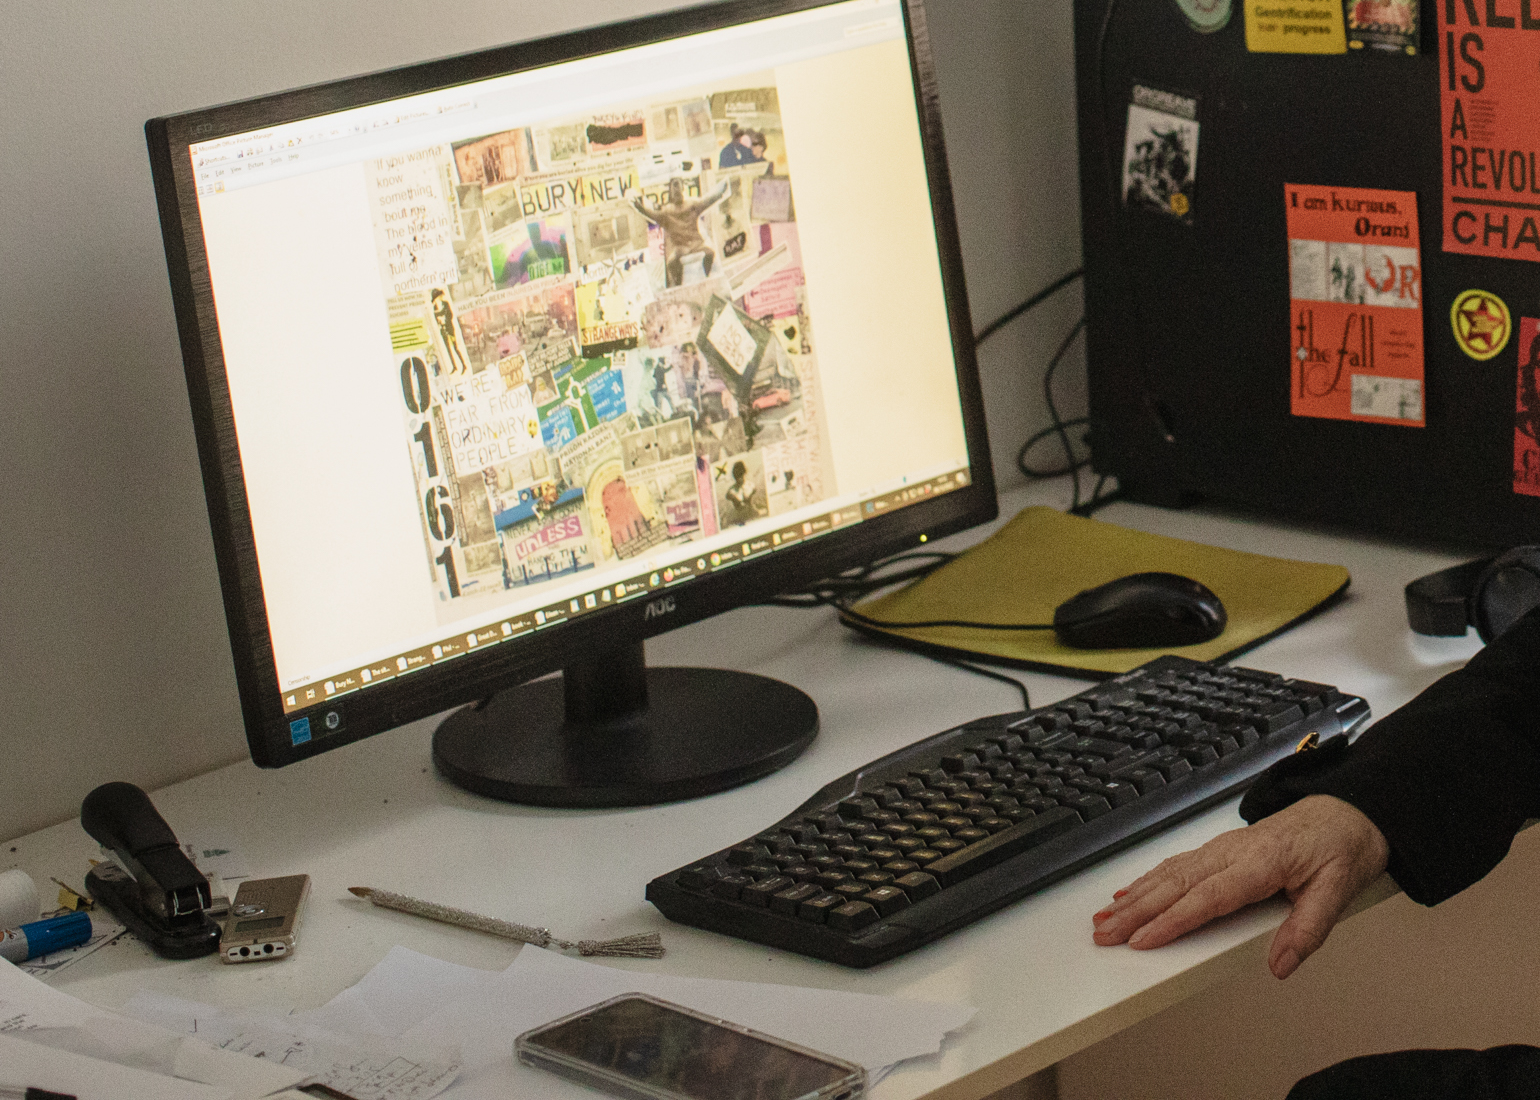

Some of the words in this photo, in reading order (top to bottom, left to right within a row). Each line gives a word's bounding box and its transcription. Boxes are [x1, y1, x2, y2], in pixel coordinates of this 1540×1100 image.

[1255, 5, 1333, 20] Gentrification
[1283, 23, 1331, 37] progress
[1446, 31, 1485, 94] IS
[1450, 97, 1468, 140] A
[386, 154, 405, 169] you
[407, 145, 444, 162] wanna
[376, 173, 403, 189] know
[379, 185, 433, 206] something
[521, 178, 581, 217] BURY
[589, 173, 633, 206] NEW
[1304, 197, 1327, 210] am
[384, 226, 405, 240] The
[408, 218, 436, 235] blood
[438, 213, 448, 227] in
[408, 237, 434, 252] veins
[435, 234, 445, 246] is
[389, 262, 406, 276] full
[393, 271, 437, 291] northern
[582, 321, 639, 345] STRANGEWAYS
[448, 404, 479, 429] FAR
[488, 389, 532, 415] FROM
[455, 436, 518, 471] PEOPLE
